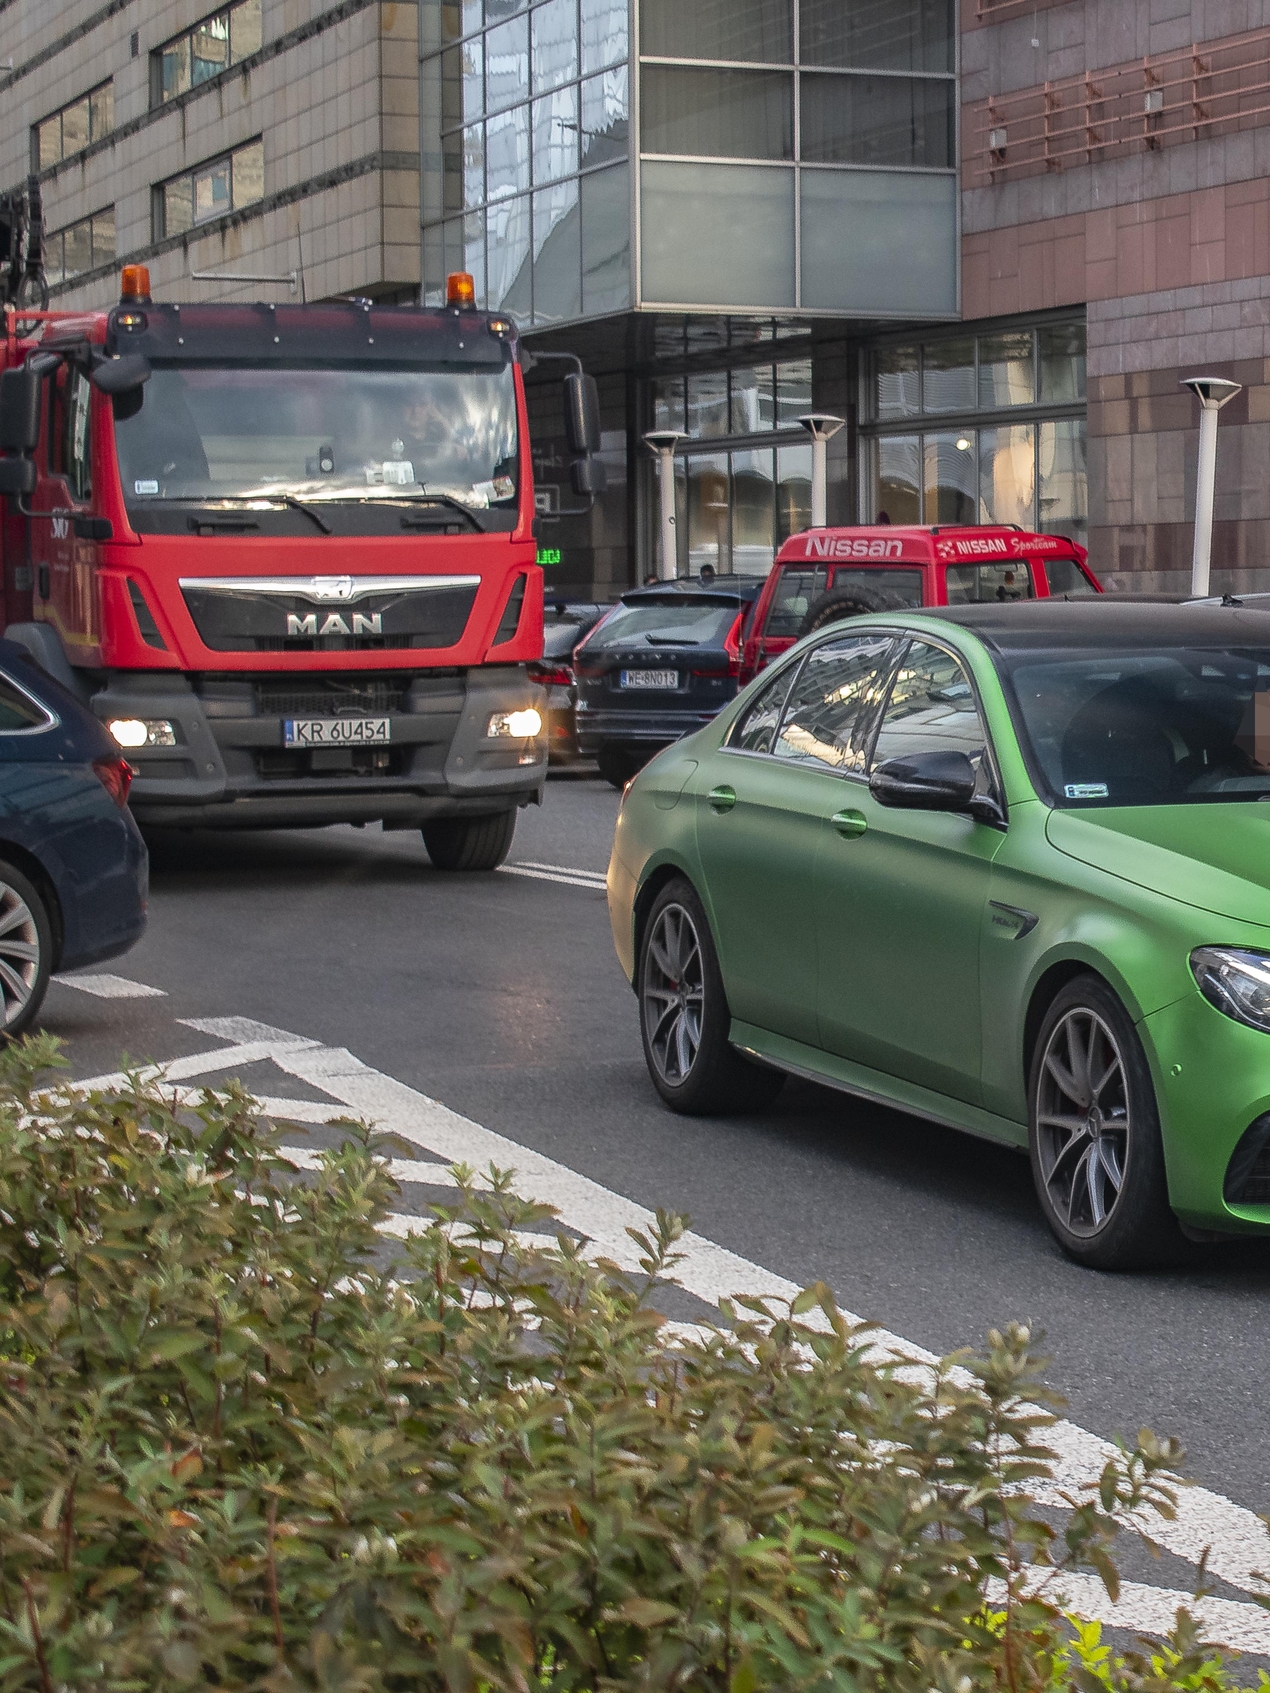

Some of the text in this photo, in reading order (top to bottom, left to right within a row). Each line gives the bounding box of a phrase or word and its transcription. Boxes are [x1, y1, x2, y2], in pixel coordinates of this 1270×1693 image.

[805, 536, 903, 557] Nissan
[955, 538, 1008, 555] NISSAN
[287, 612, 383, 635] MAN
[628, 671, 676, 687] WE 8N013
[297, 722, 323, 741] KR
[330, 721, 386, 740] 6U454
